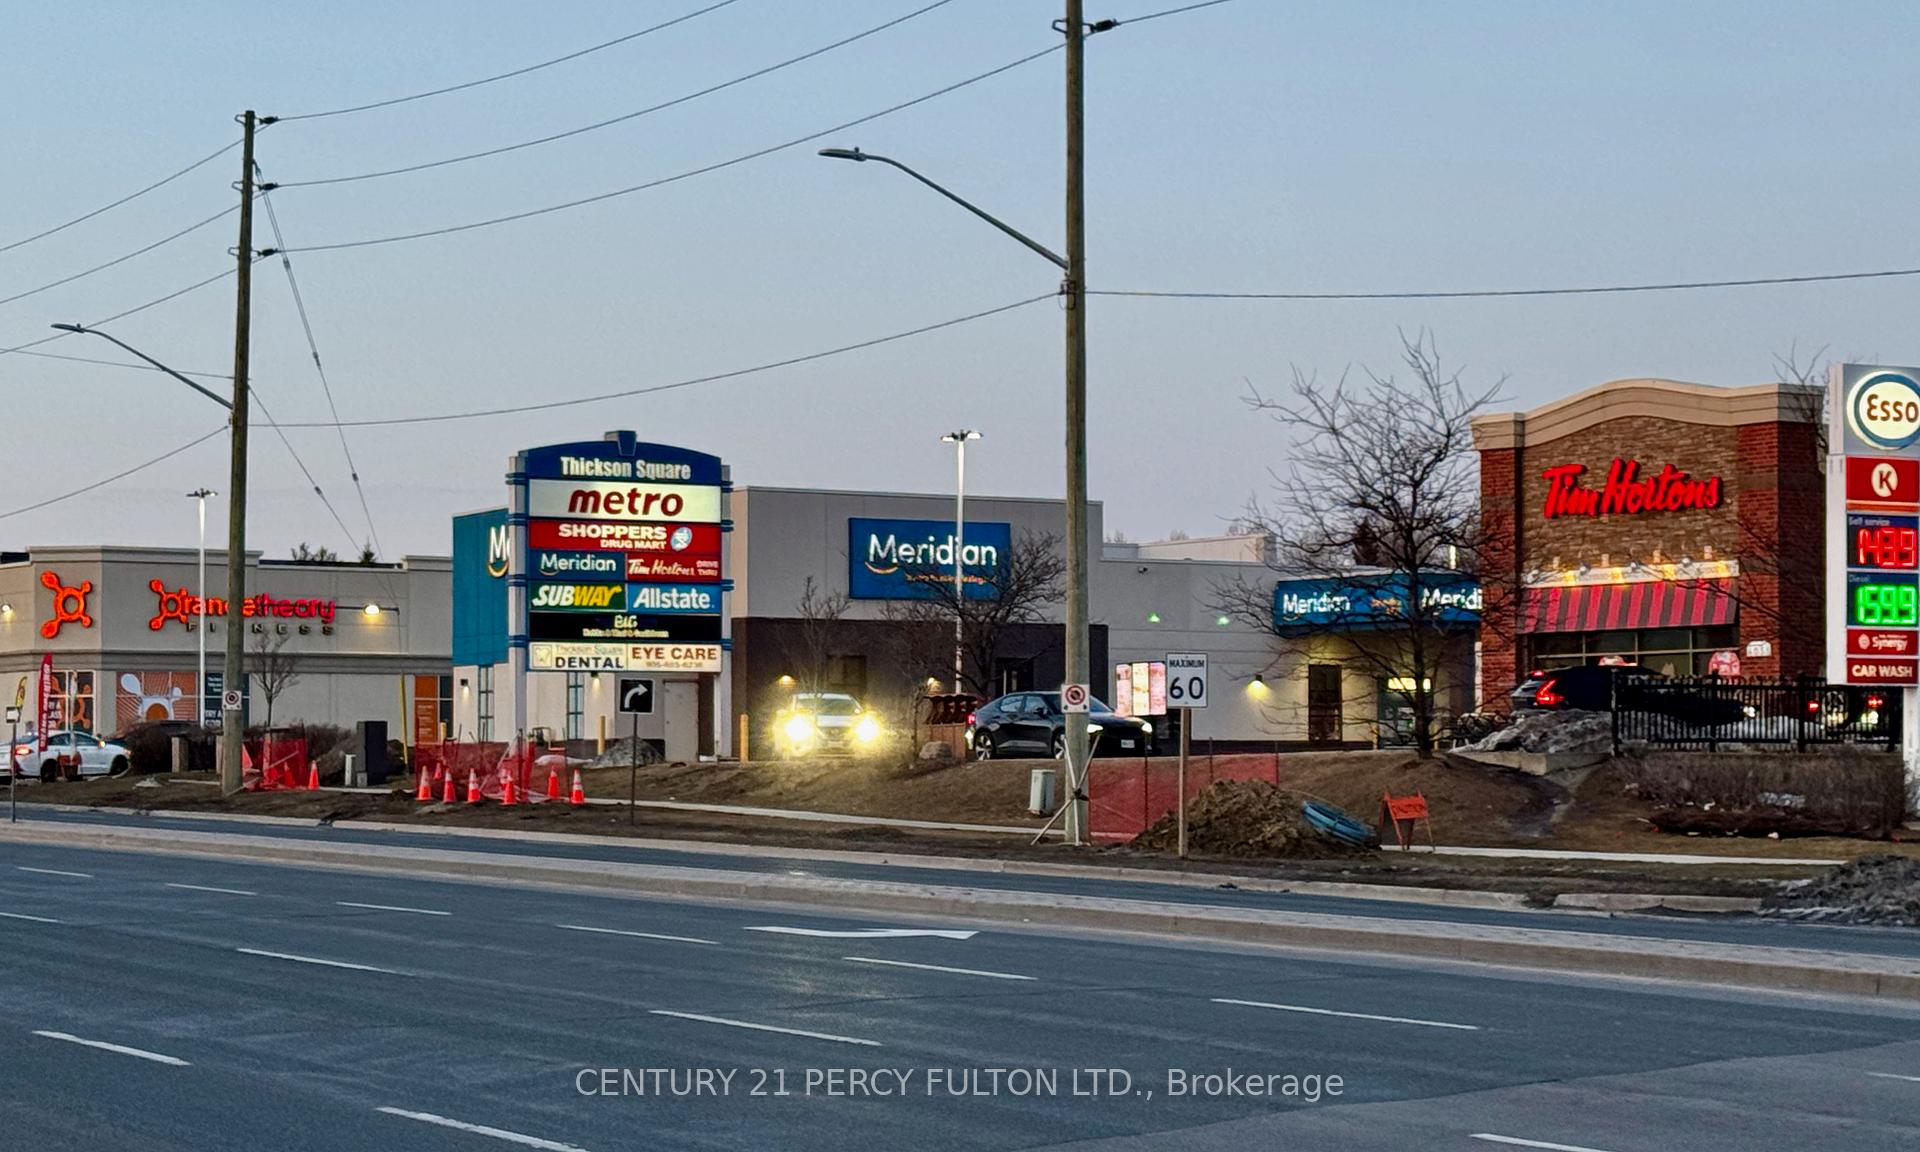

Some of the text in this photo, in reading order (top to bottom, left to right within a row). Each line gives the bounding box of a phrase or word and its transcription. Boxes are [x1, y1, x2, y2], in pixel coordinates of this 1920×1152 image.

[1867, 393, 1919, 423] Esso
[560, 456, 692, 480] Thickson Square
[1541, 456, 1724, 519] Tim Hortons
[568, 487, 684, 517] metro
[558, 523, 668, 541] SHOPPERS
[600, 539, 667, 549] DRUG MART
[868, 534, 999, 566] Meridian
[540, 552, 617, 572] Meridian
[628, 558, 650, 575] Tim
[532, 584, 622, 607] SUBWAY
[632, 587, 711, 610] Allstate
[1283, 591, 1350, 614] Meridian
[186, 622, 335, 636] FINESS
[555, 656, 624, 669] DENTAL
[632, 647, 717, 661] EYE CARE
[1169, 659, 1205, 668] MAXIMUM
[1852, 664, 1913, 677] CAR WASH
[1170, 676, 1204, 700] 60
